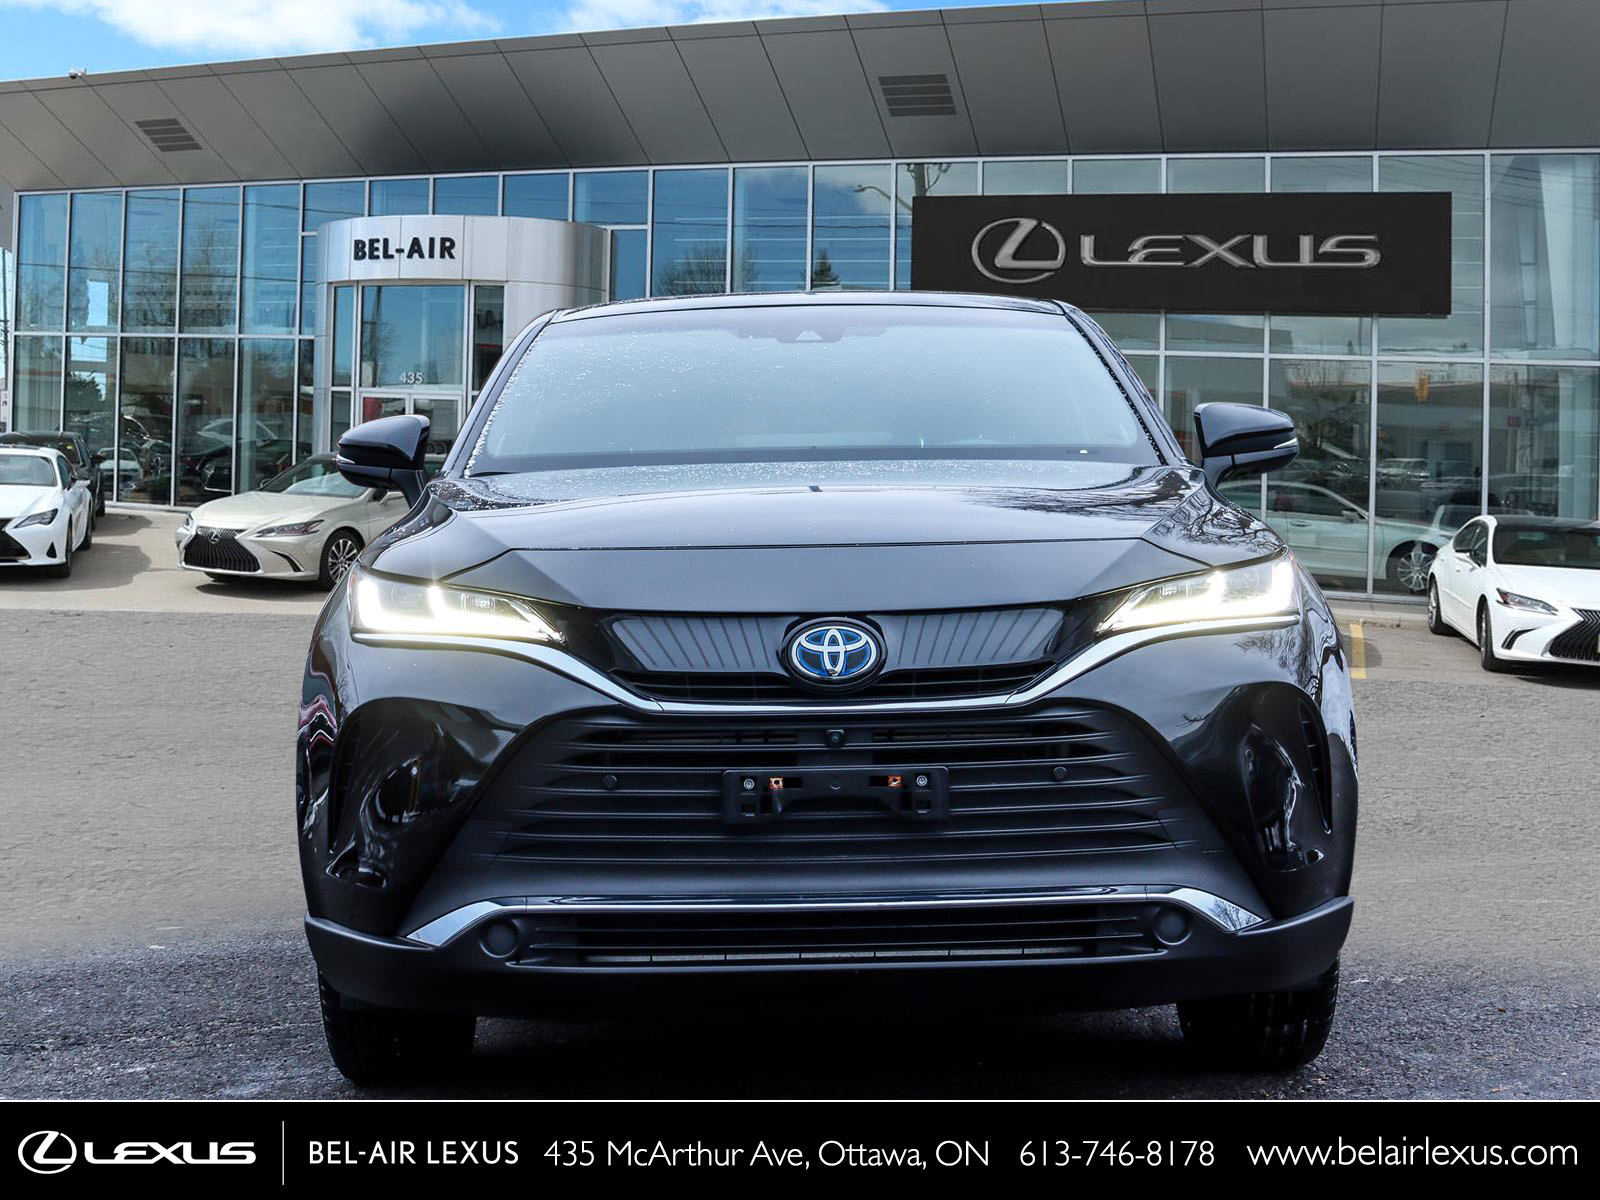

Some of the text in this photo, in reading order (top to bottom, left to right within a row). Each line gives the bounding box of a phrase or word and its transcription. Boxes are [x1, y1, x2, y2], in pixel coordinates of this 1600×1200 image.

[353, 236, 456, 261] BEL-AIR
[1080, 233, 1381, 269] LEXUS
[400, 371, 423, 385] 435
